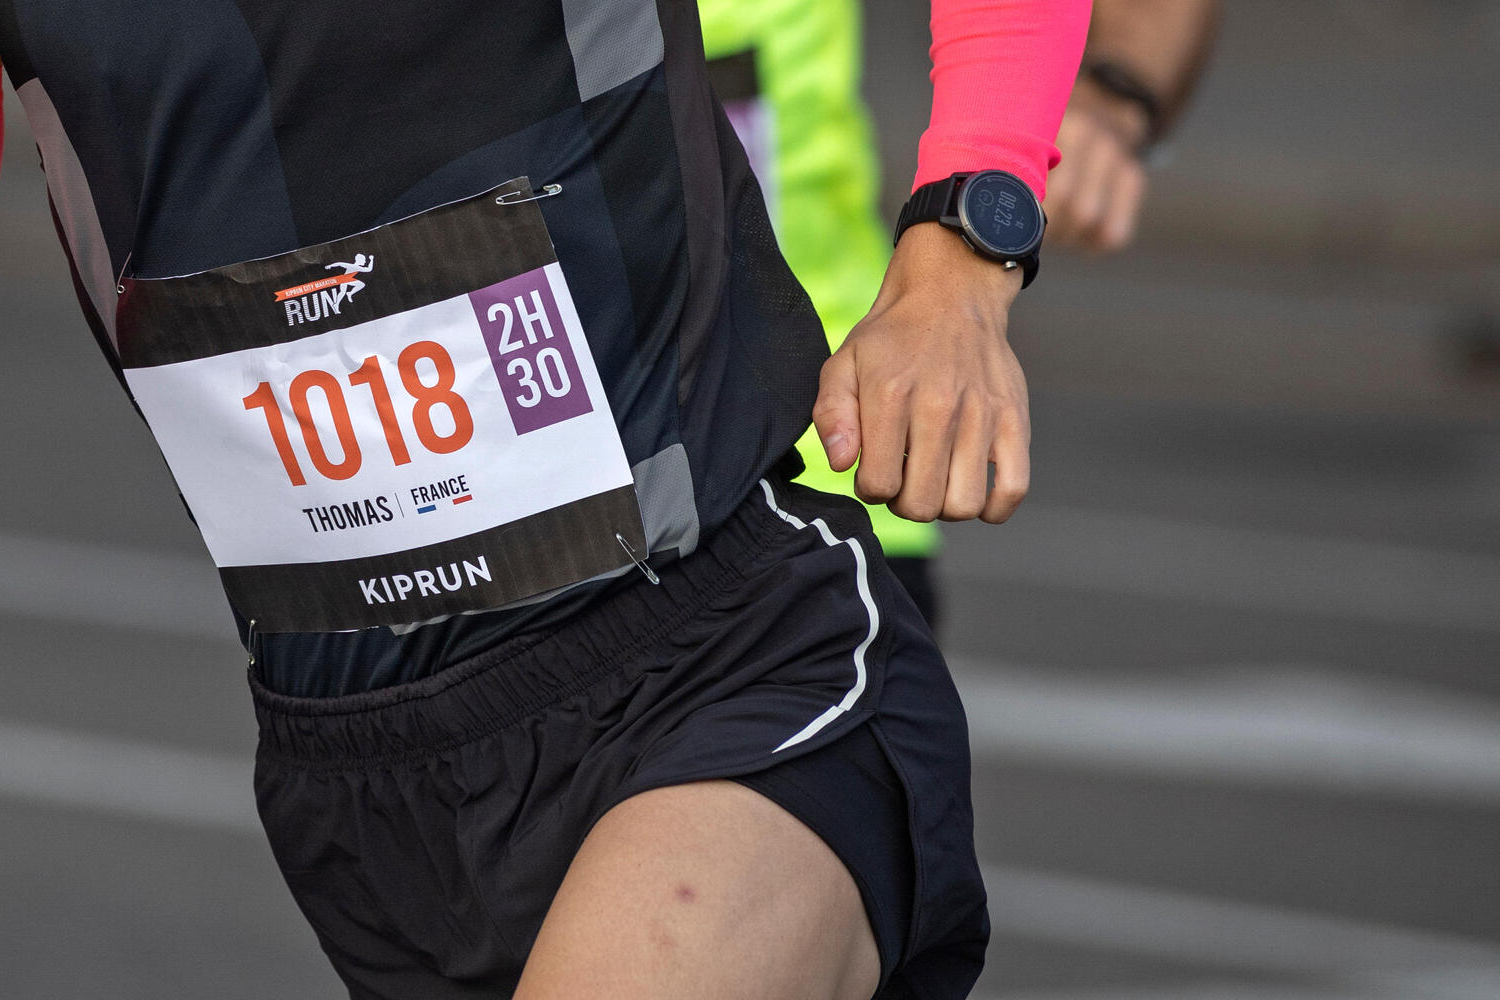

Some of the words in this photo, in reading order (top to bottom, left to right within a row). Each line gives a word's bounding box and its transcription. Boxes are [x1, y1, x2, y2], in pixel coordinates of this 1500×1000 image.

[284, 288, 340, 326] RUN
[487, 289, 554, 355] 2H
[506, 347, 572, 408] 30
[242, 340, 474, 486] 1018
[302, 495, 394, 532] THOMAS
[410, 474, 470, 505] FRANCE
[358, 555, 493, 605] KIPRUN
